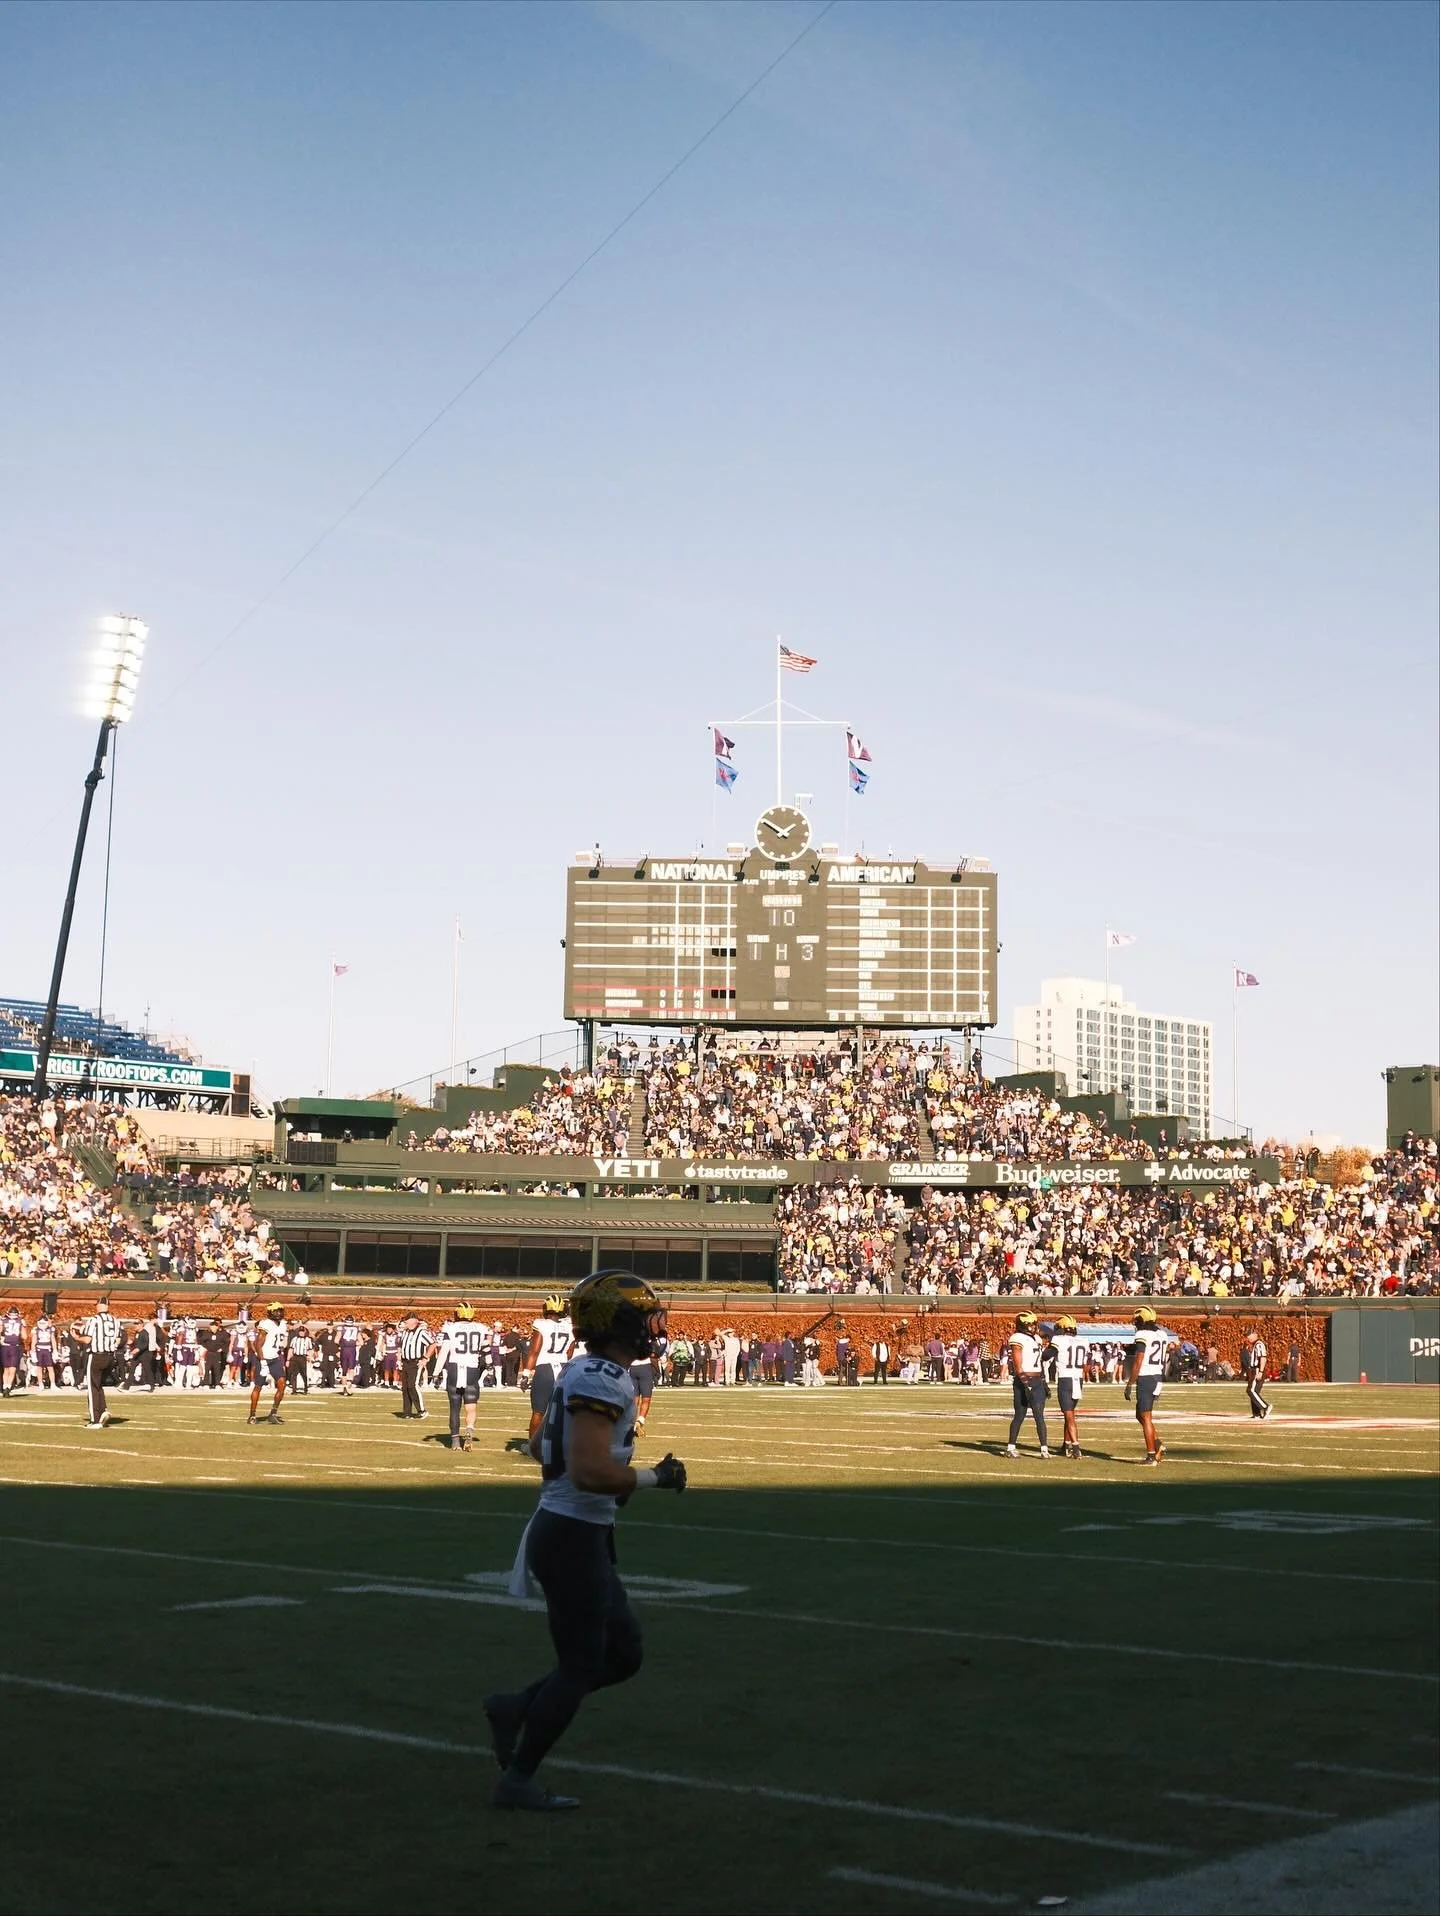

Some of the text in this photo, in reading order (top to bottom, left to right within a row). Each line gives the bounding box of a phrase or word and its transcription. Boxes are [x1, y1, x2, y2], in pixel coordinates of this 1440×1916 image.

[650, 863, 738, 881] NATIONAL
[759, 870, 806, 881] UMPIRES
[827, 865, 915, 883] AMERICAN
[32, 1055, 203, 1086] RIGLEYROOFTOPS.COM
[593, 1158, 660, 1178] YETI
[697, 1165, 789, 1180] tastytrade
[1168, 1163, 1250, 1181] Advocate
[454, 1331, 481, 1354] 30
[547, 1332, 569, 1354] 17
[1066, 1345, 1085, 1369] 10
